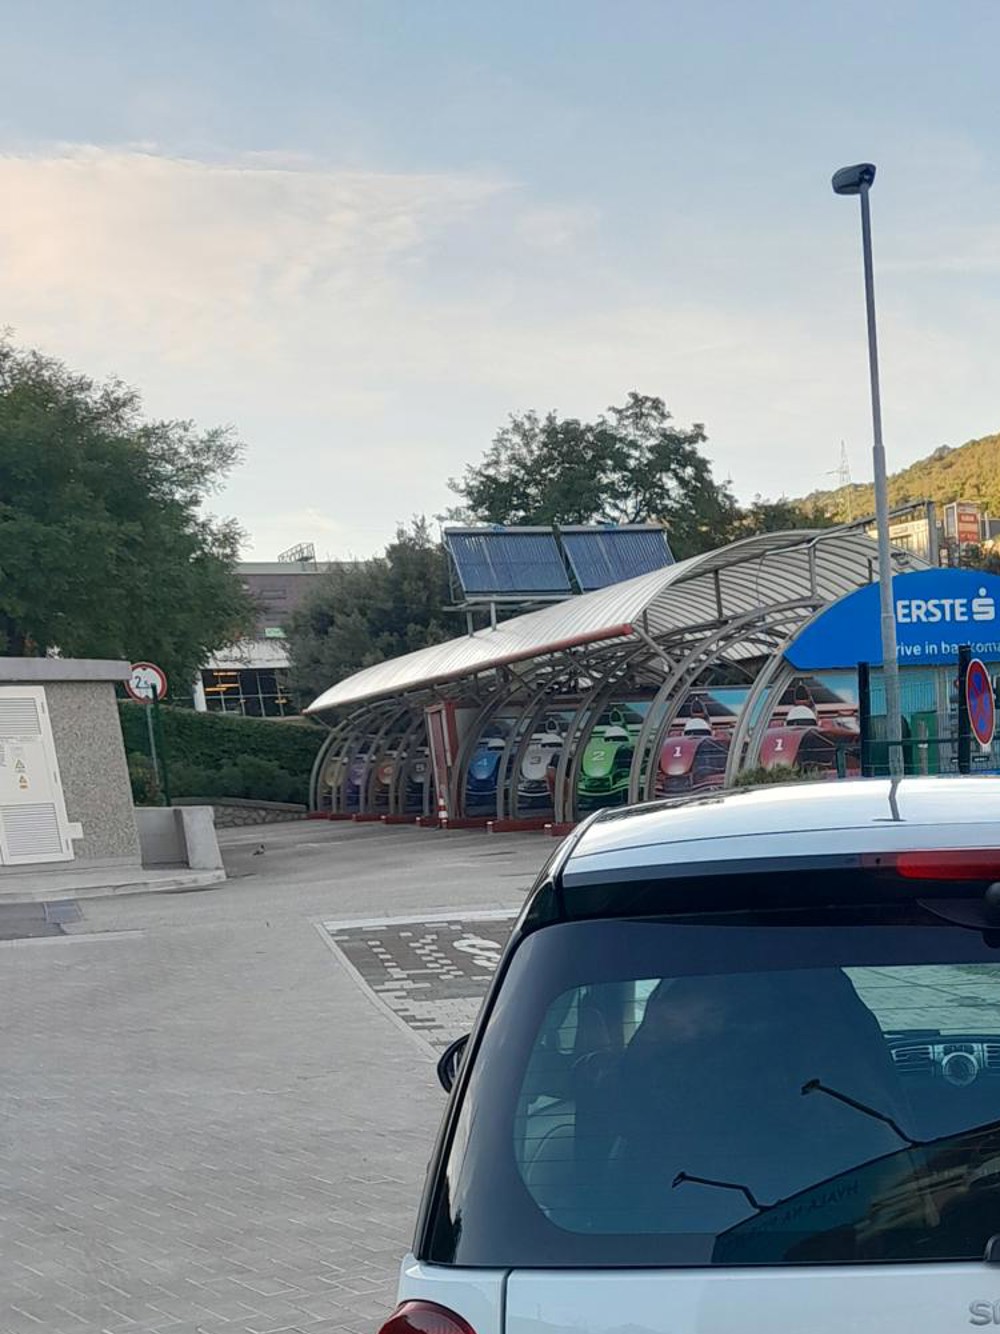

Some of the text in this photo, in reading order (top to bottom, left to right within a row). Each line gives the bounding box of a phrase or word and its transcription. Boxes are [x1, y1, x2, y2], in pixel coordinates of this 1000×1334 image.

[896, 599, 968, 623] ERSTE
[895, 642, 921, 656] rive
[925, 641, 938, 655] in
[774, 738, 784, 750] 1
[591, 751, 605, 761] 2
[673, 746, 682, 757] 1
